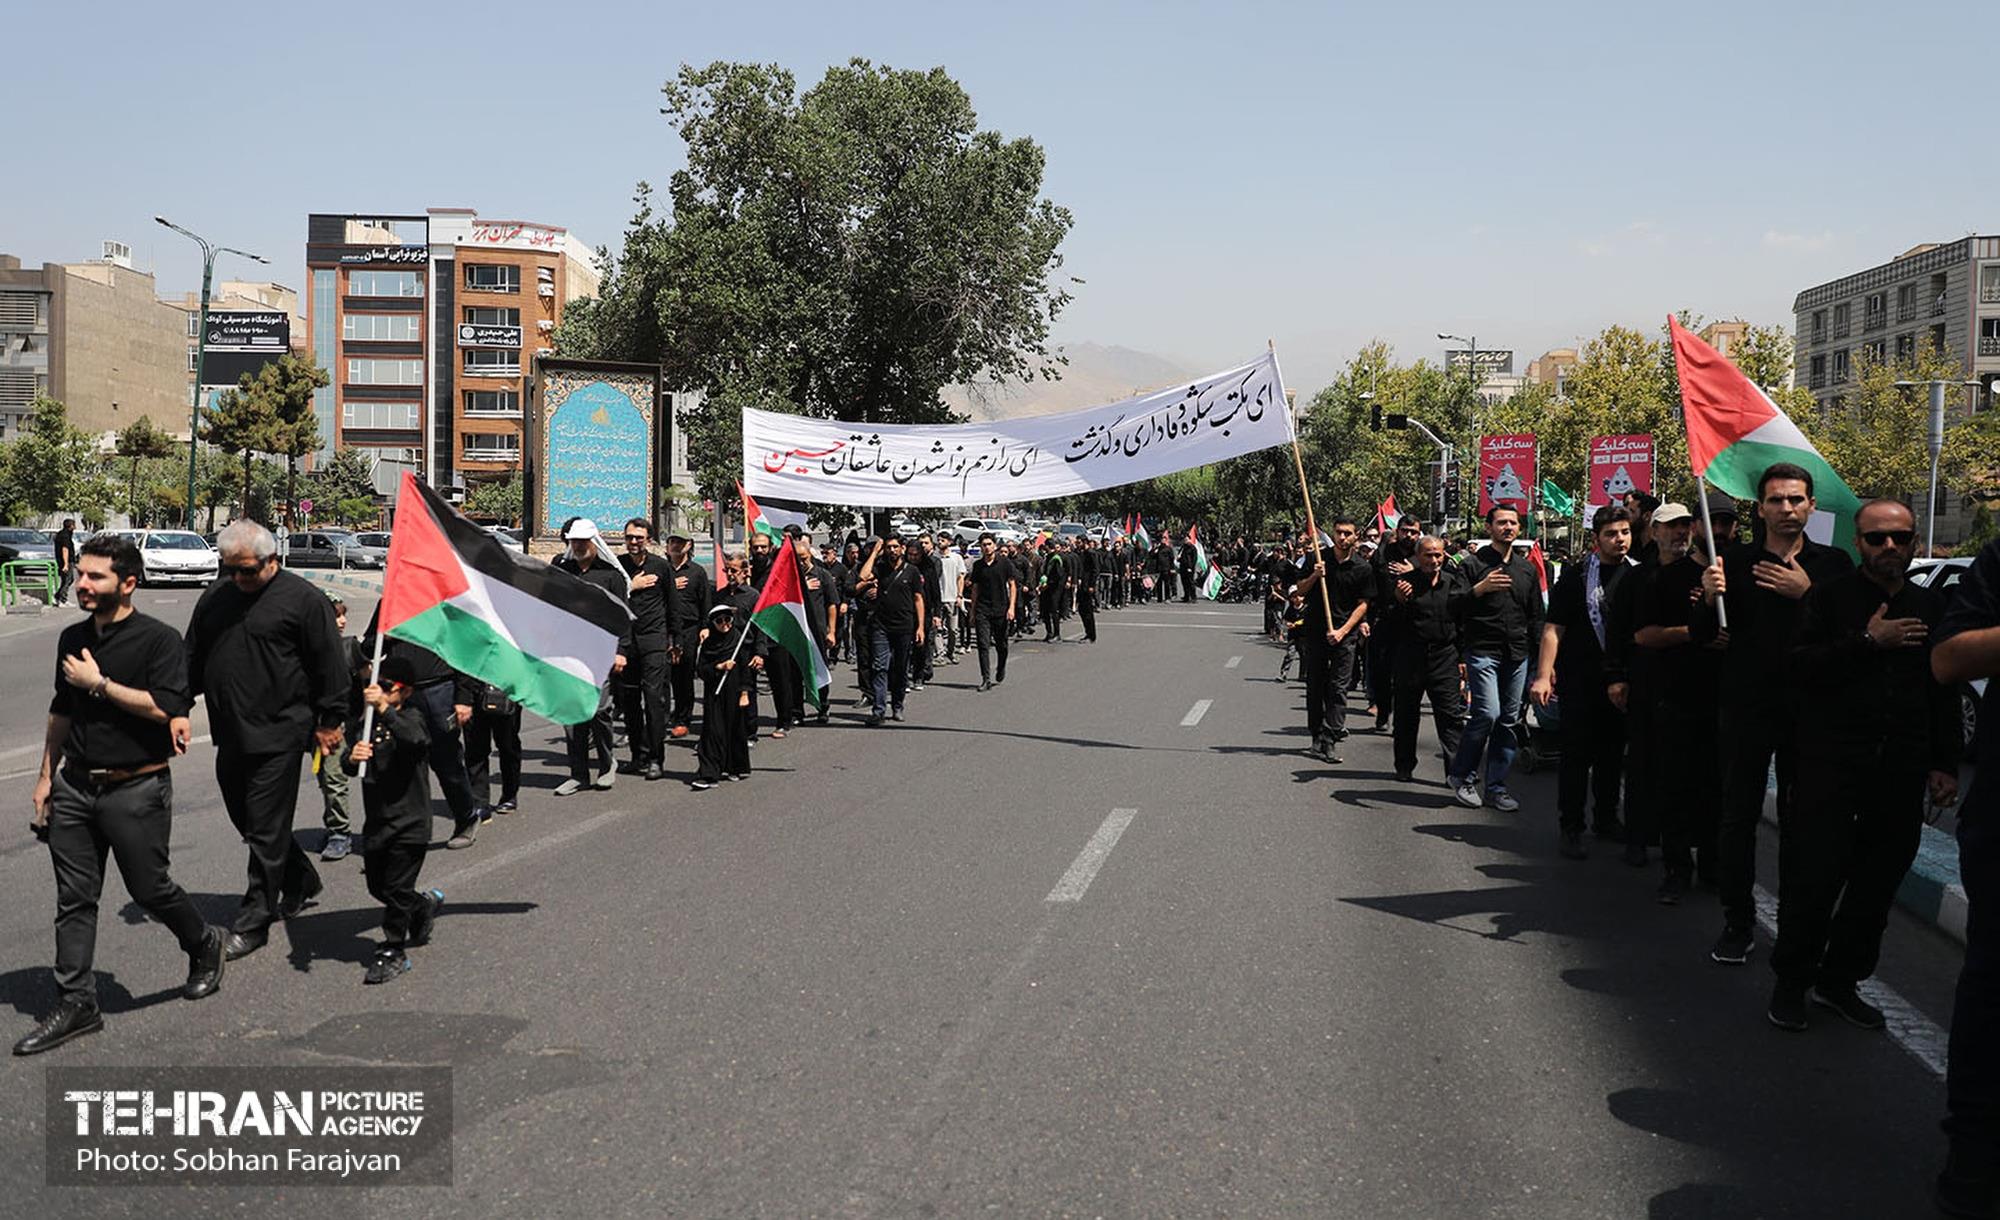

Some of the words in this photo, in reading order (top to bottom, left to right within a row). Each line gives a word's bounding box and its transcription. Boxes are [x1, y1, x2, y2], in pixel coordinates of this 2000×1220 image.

[364, 247, 390, 261] آسمان
[389, 246, 428, 262] فیزیوتراپی
[222, 314, 250, 325] موسیقی
[251, 314, 283, 325] آموزشگاه
[477, 329, 504, 337] حیدری
[1210, 369, 1256, 437] مکتب
[1247, 383, 1273, 422] ای
[1064, 414, 1126, 463] گذشت
[1483, 438, 1513, 452] کلیک
[1593, 438, 1627, 453] کلیک
[1628, 441, 1649, 450] سه
[763, 440, 846, 474] حسین
[821, 433, 891, 476] عاشقان
[892, 440, 945, 484] شدن
[1009, 446, 1038, 477] ای
